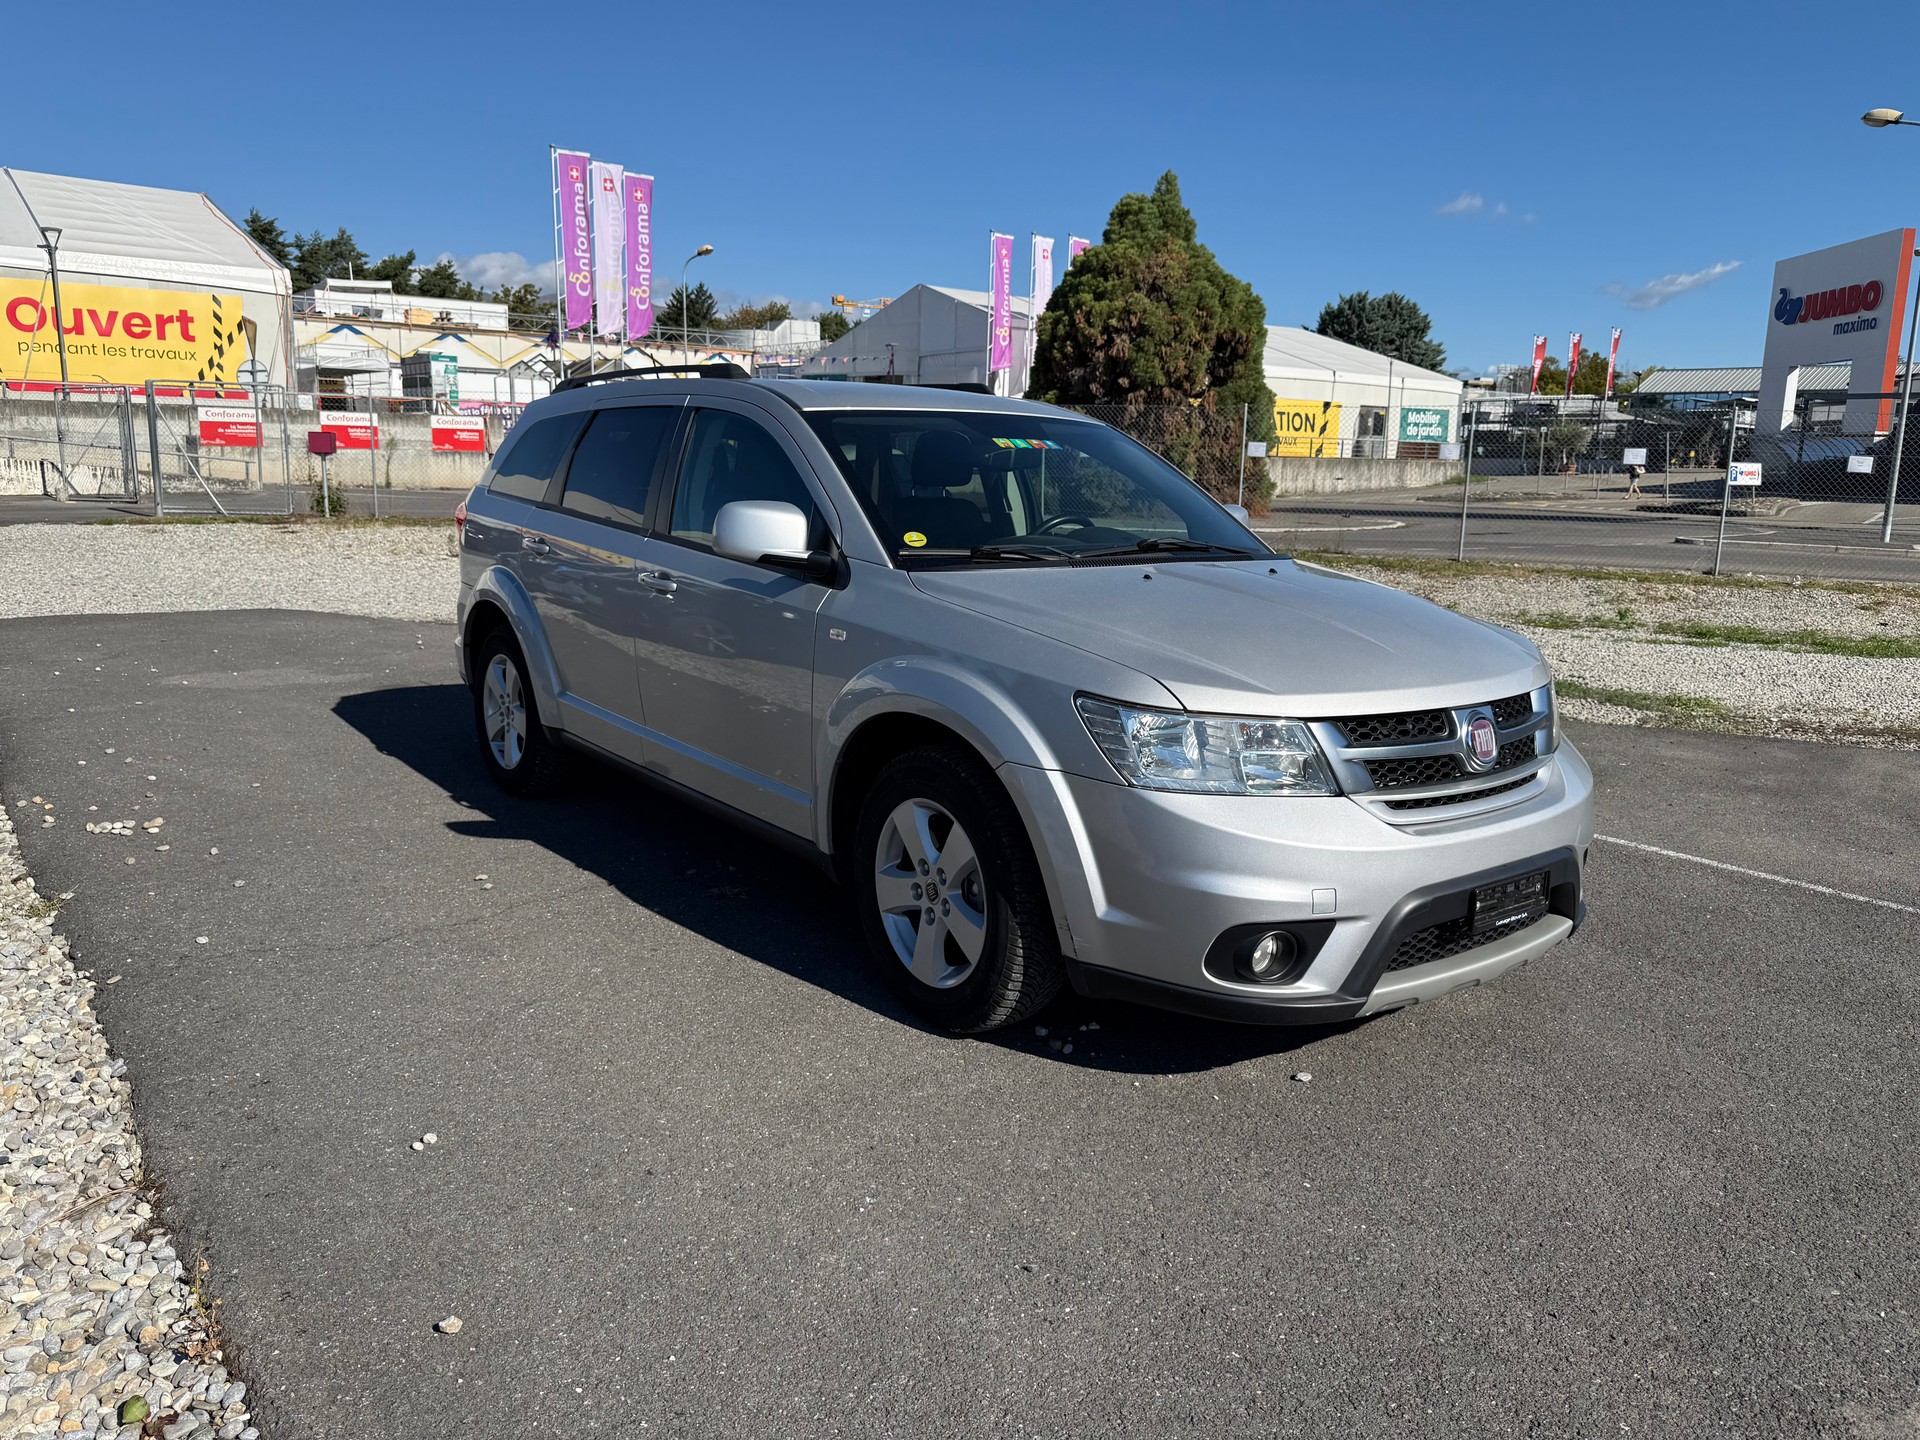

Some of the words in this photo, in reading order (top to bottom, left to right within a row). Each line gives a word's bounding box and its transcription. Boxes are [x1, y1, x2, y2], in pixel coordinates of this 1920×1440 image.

[573, 183, 591, 297] Conforama
[634, 203, 650, 311] Conforama
[999, 258, 1011, 346] Conforama
[1797, 280, 1883, 323] JUMBO
[5, 296, 196, 343] Ouvert
[1832, 316, 1878, 336] maximo
[103, 343, 127, 357] les
[131, 346, 197, 361] travaux
[205, 409, 256, 419] Conforama
[436, 417, 479, 426] Conforama
[1273, 411, 1316, 433] TION
[1407, 411, 1441, 424] Mobilier
[1278, 437, 1298, 446] VAUX
[1407, 425, 1417, 435] de
[1417, 426, 1442, 439] jardin
[1474, 728, 1493, 752] FIAT
